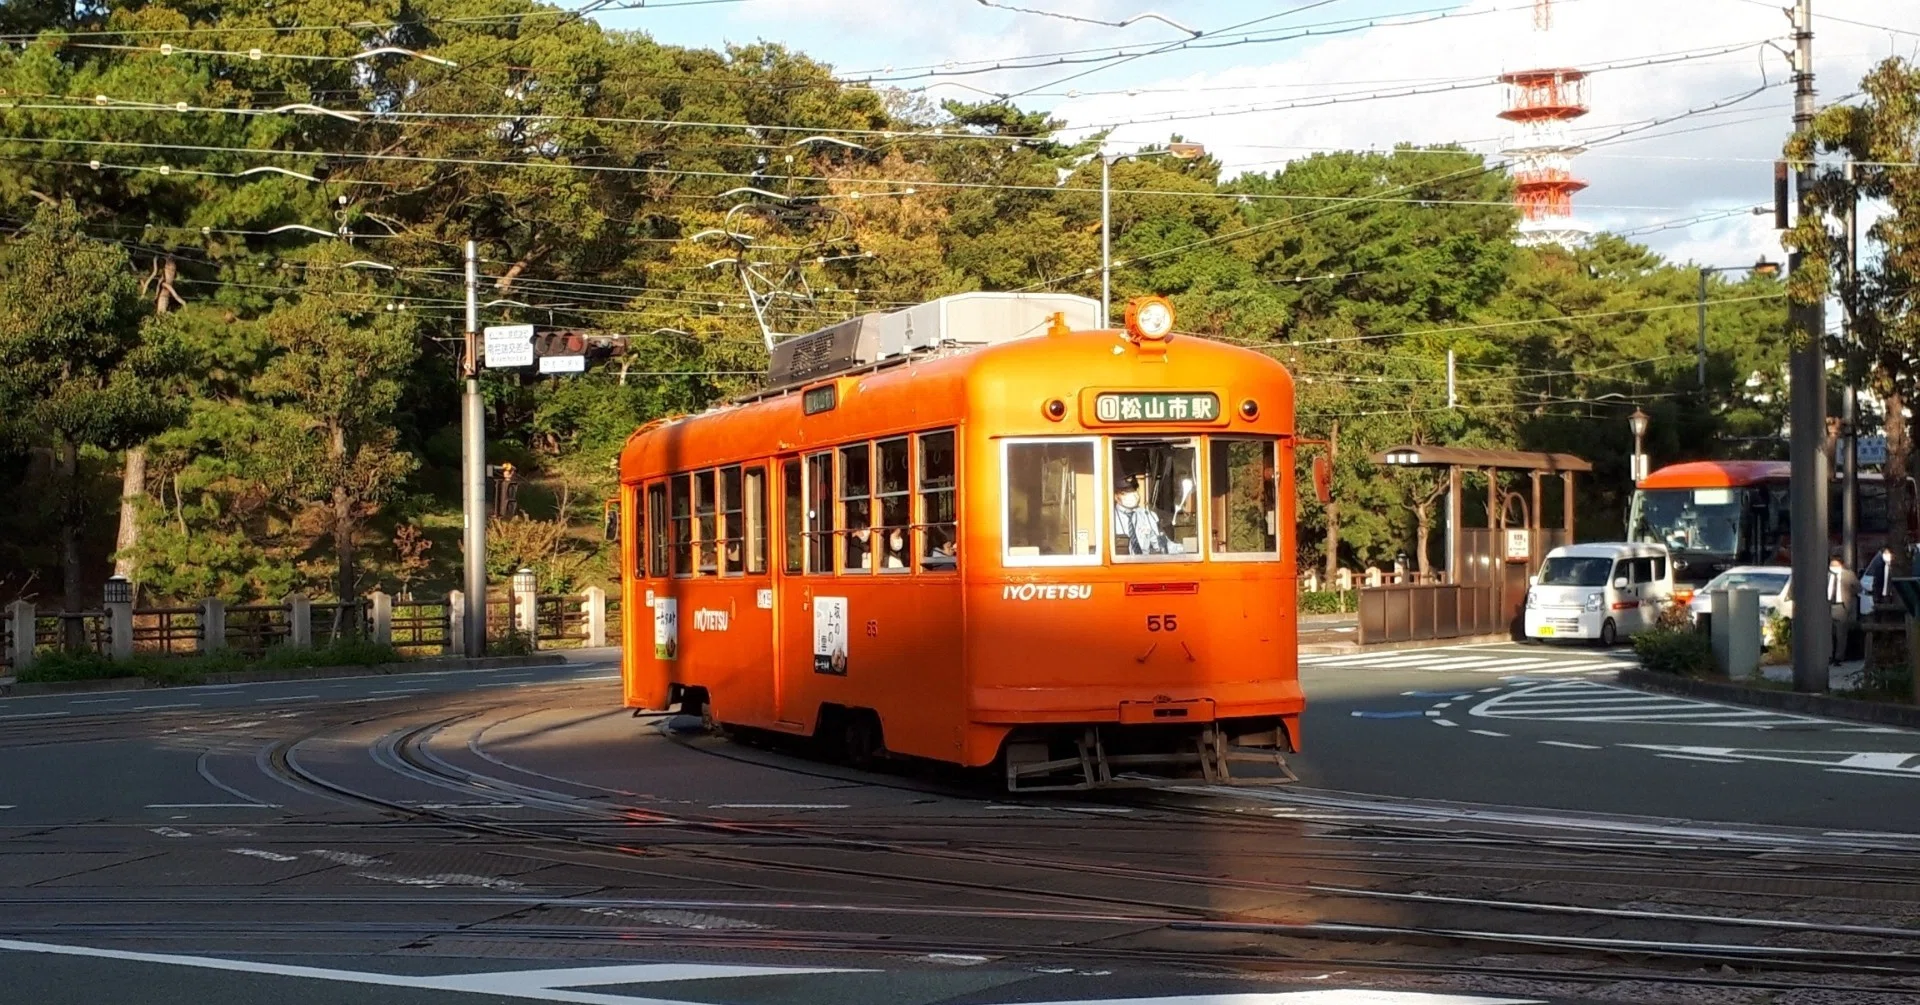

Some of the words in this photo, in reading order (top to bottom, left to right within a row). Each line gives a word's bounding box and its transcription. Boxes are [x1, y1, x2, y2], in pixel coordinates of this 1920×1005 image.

[1121, 397, 1212, 420] 松山市駅
[1003, 583, 1092, 601] IYOTETSU
[693, 607, 729, 632] IYOTETSU
[1147, 614, 1177, 632] 55
